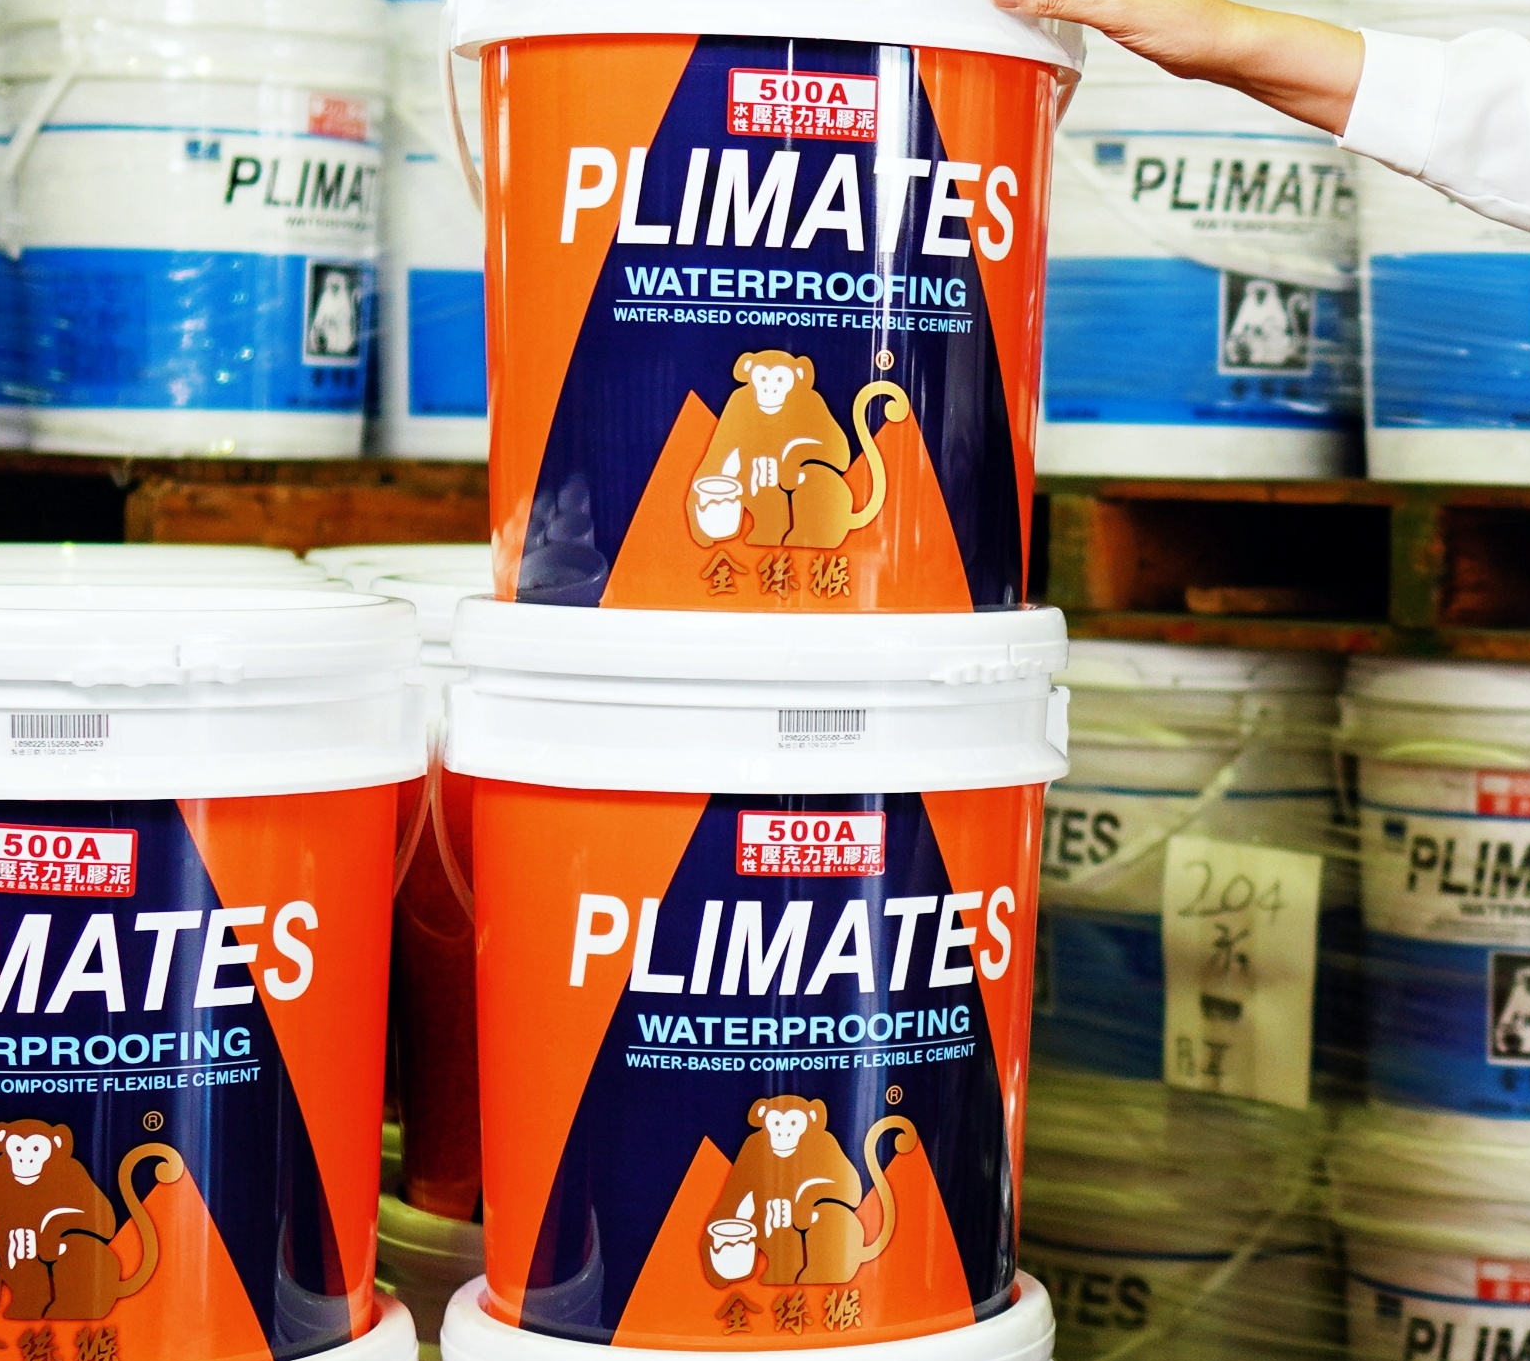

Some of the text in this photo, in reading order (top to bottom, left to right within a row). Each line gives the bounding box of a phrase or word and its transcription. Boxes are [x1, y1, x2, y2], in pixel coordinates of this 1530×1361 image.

[759, 79, 848, 105] 500A
[560, 147, 1019, 262] PLIMATES
[625, 267, 967, 307] WATERPROOFING
[614, 307, 973, 333] WATER-BASED COMPOSITE FLEXIBLE CEMENT
[768, 819, 855, 842] 500A
[4, 833, 101, 861] 500A
[569, 885, 1016, 995] PLIMATES
[638, 1006, 969, 1044] WATERPROOFING
[103, 1073, 188, 1093] FLEXIBLE
[192, 1067, 261, 1088] CEMENT
